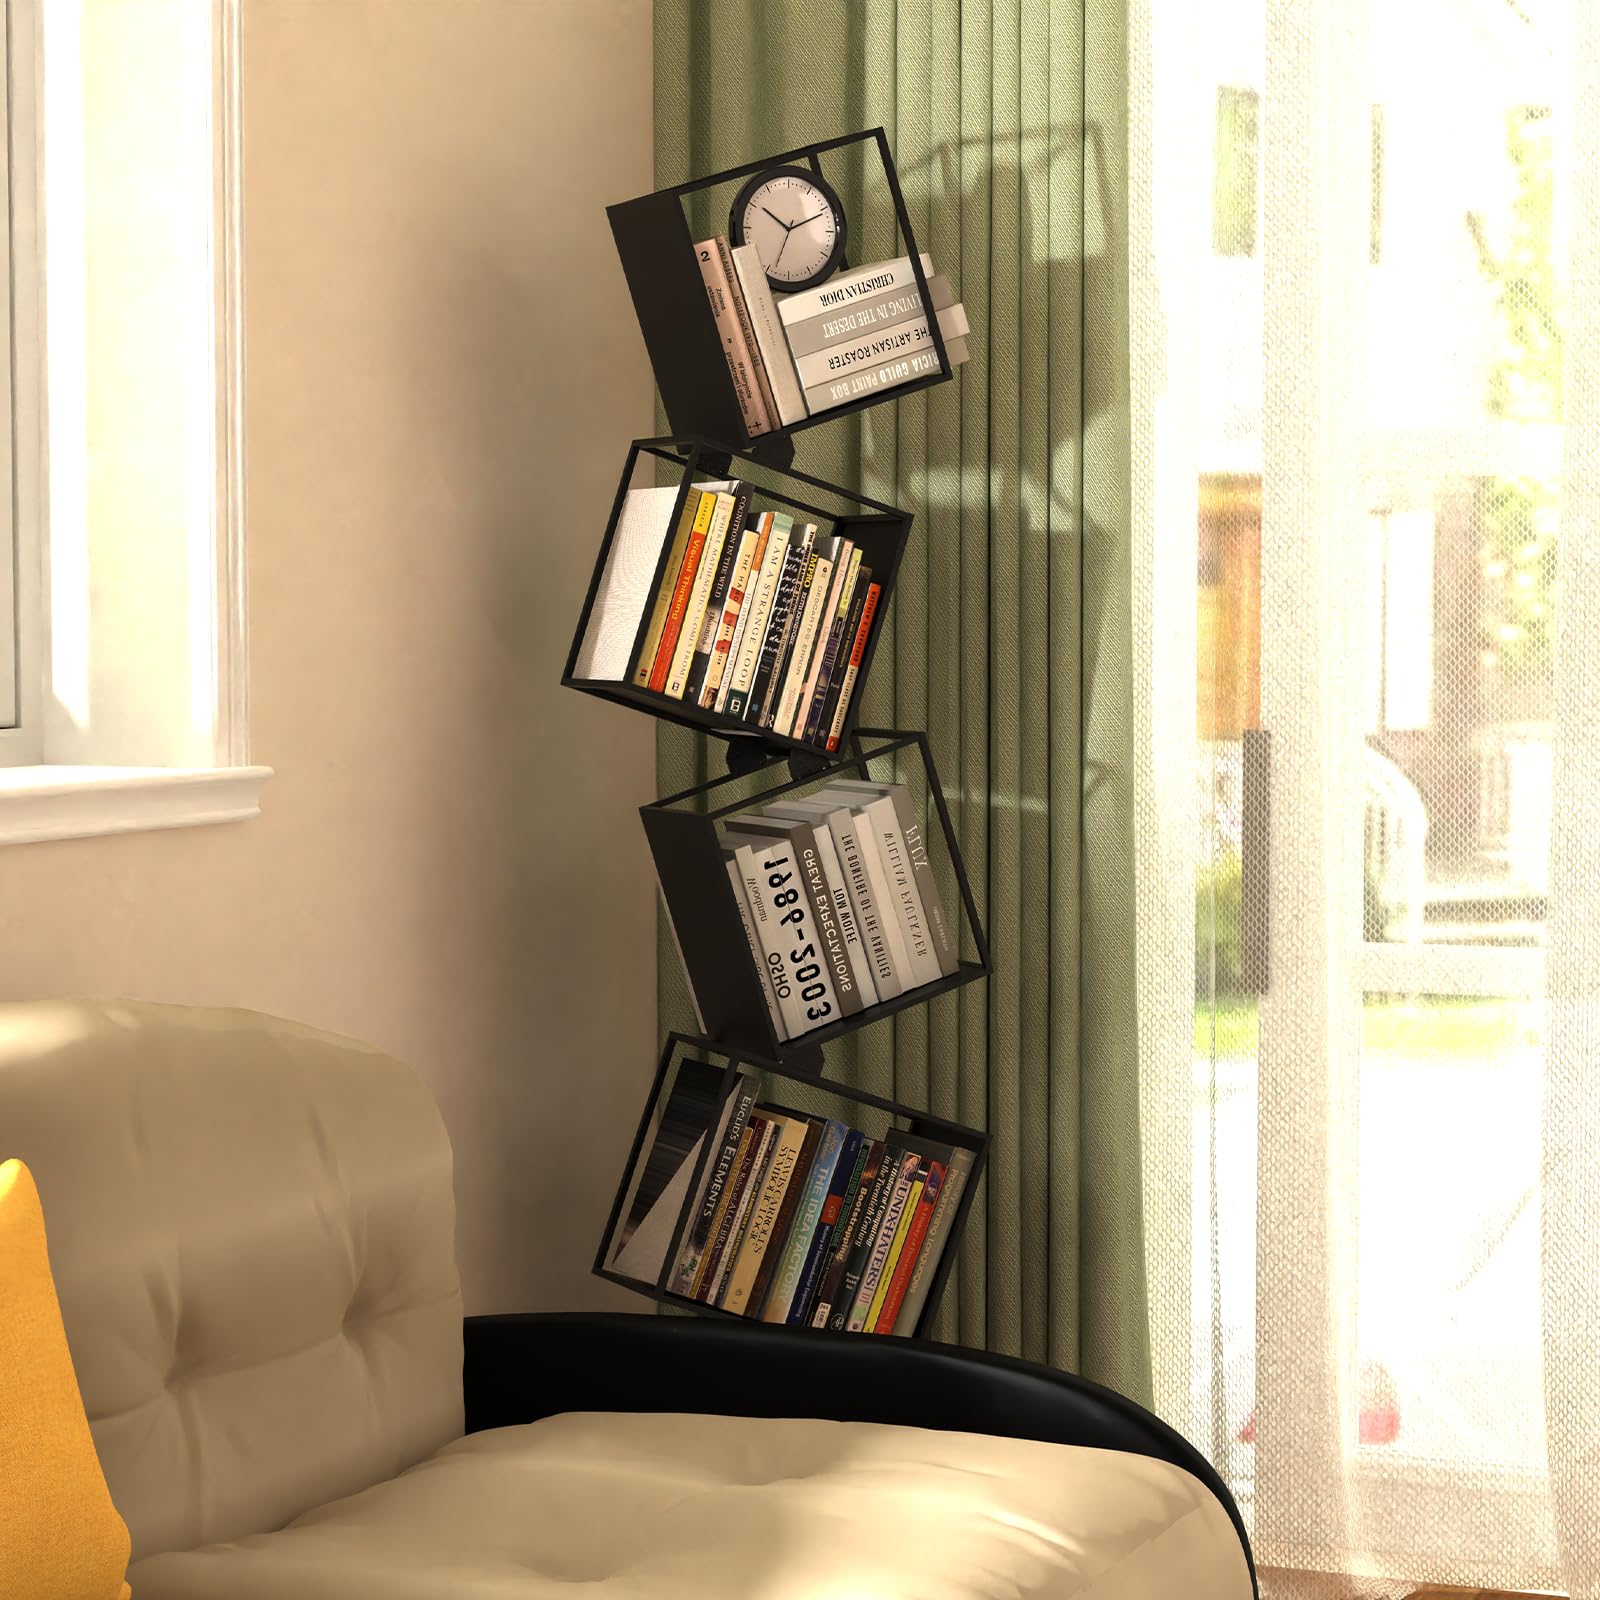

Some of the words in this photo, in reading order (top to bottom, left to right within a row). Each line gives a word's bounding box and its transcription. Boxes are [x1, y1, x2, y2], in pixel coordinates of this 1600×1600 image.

[700, 250, 711, 262] 2
[716, 241, 727, 260] ANNI
[722, 259, 735, 284] ALBERS
[818, 288, 845, 307] DIOR
[843, 271, 895, 299] CHRISTIAN
[733, 294, 749, 332] NOTEBOOK
[855, 307, 876, 327] THE
[874, 303, 889, 320] IN
[886, 292, 922, 317] LIVING
[820, 314, 858, 339] DESERT
[826, 344, 872, 370] ROASTER
[870, 330, 913, 355] ARTISAN
[849, 371, 879, 393] PAINT
[877, 360, 910, 383] GUILD
[828, 381, 851, 400] BOX
[713, 513, 727, 544] WHERE
[728, 494, 747, 544] COGNITION
[684, 537, 700, 572] Visual
[725, 544, 734, 556] IN
[740, 552, 751, 571] THE
[769, 544, 781, 565] AM
[802, 543, 811, 563] INNER
[720, 555, 731, 575] THE
[765, 569, 775, 579] A
[797, 563, 806, 582] GAME
[802, 552, 819, 589] IMPRO
[695, 547, 718, 614] MATHEMATICS
[713, 574, 726, 599] WILD
[731, 574, 745, 602] HAND
[794, 582, 801, 592] OF
[670, 573, 691, 621] Thinking
[788, 592, 798, 615] TENNIS
[700, 610, 717, 646] Hutchins
[748, 582, 771, 645] STRANGE
[686, 615, 700, 648] COMES
[678, 649, 691, 677] FROM
[737, 648, 754, 687] LOOP
[775, 1146, 797, 1190] LEWIS
[878, 1163, 890, 1179] the
[883, 1154, 893, 1165] in
[760, 1143, 789, 1208] SYMBOLIC
[811, 1164, 829, 1196] THE
[881, 1165, 899, 1198] History
[865, 1176, 885, 1217] Twentieth
[880, 1195, 889, 1206] of
[928, 1166, 959, 1237] Programming
[714, 1199, 738, 1251] ALGEBRA
[746, 1206, 767, 1246] LOGIC
[799, 1197, 819, 1234] IDEA
[834, 1184, 868, 1263] Bootstrapping
[864, 1203, 886, 1248] Computing
[853, 1213, 873, 1248] Century
[864, 1184, 908, 1288] UNIX-HATERS
[776, 1233, 808, 1305] FACTORY
[908, 1236, 935, 1295] Languages
